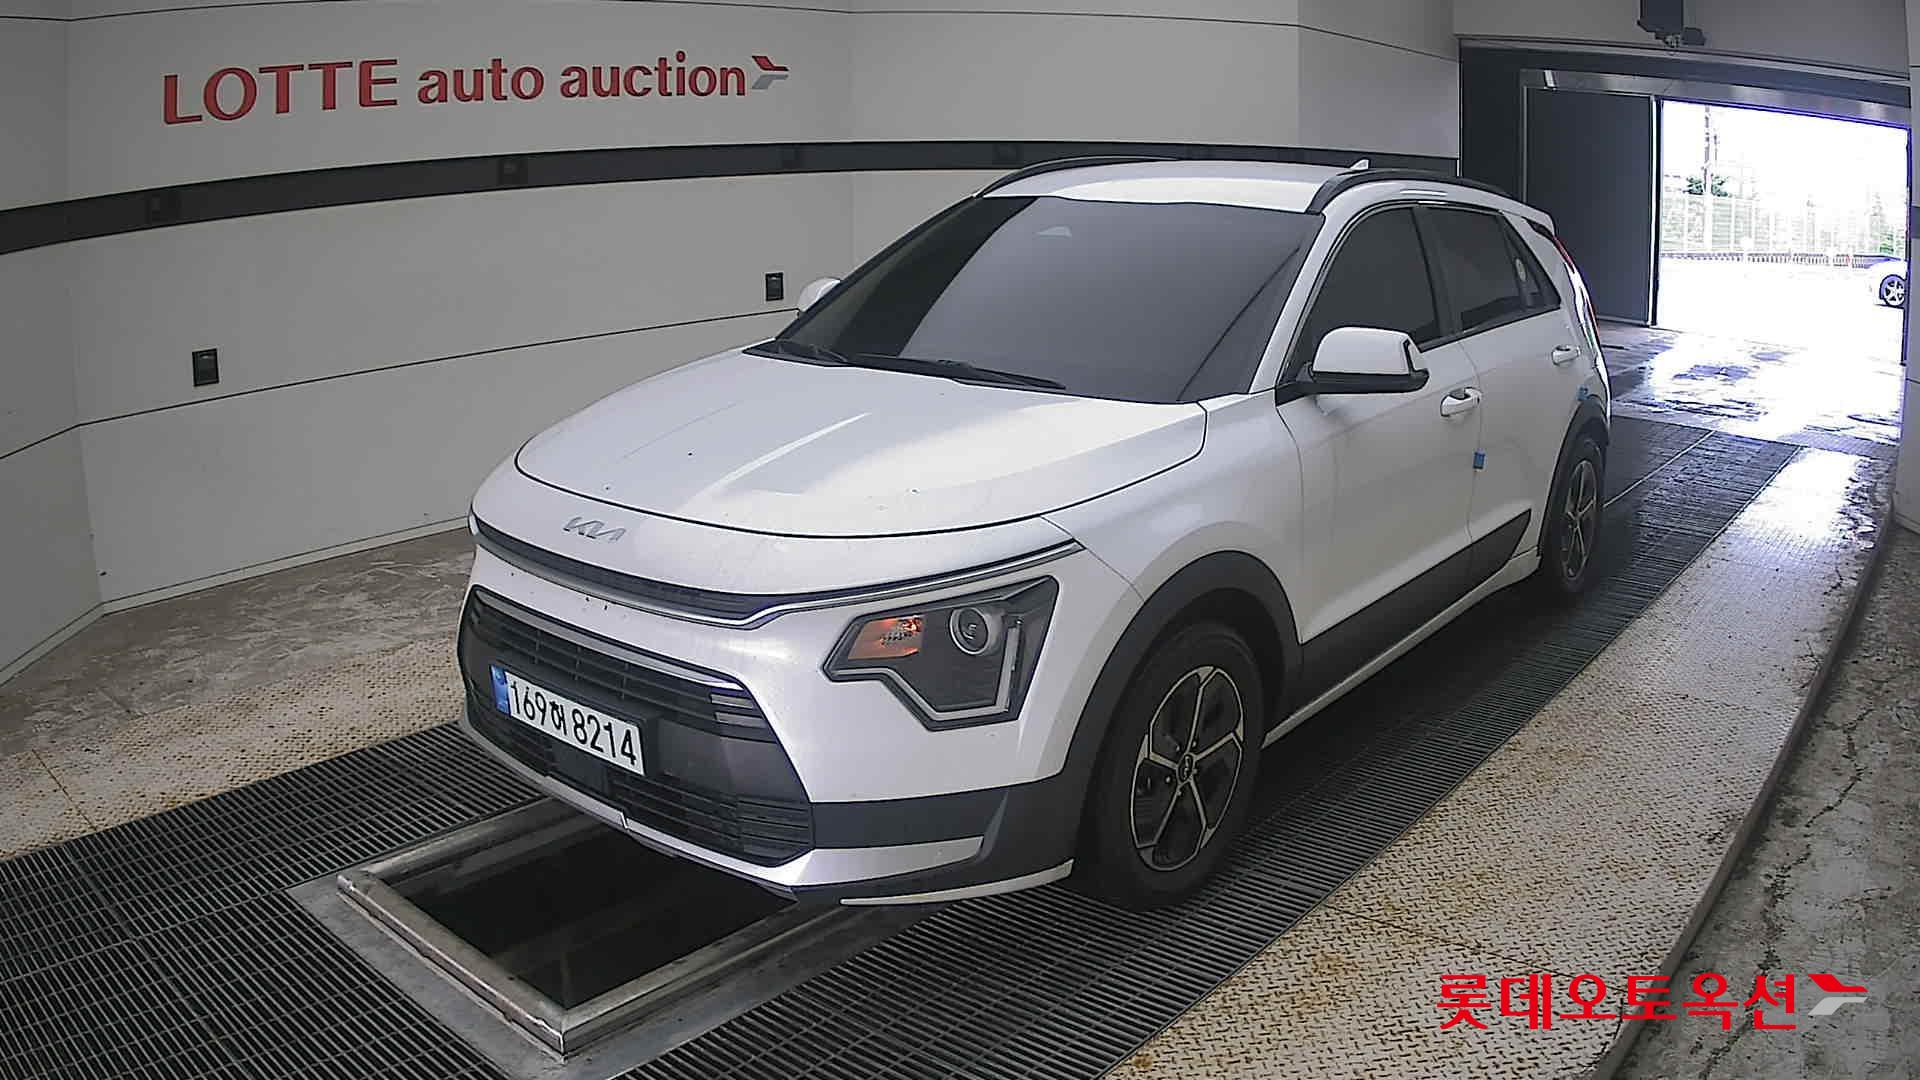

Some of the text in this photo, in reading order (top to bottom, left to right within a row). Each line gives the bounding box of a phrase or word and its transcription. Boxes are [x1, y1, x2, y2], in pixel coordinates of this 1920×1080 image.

[163, 51, 746, 125] LOTTE auto auction
[572, 708, 637, 766] 8214
